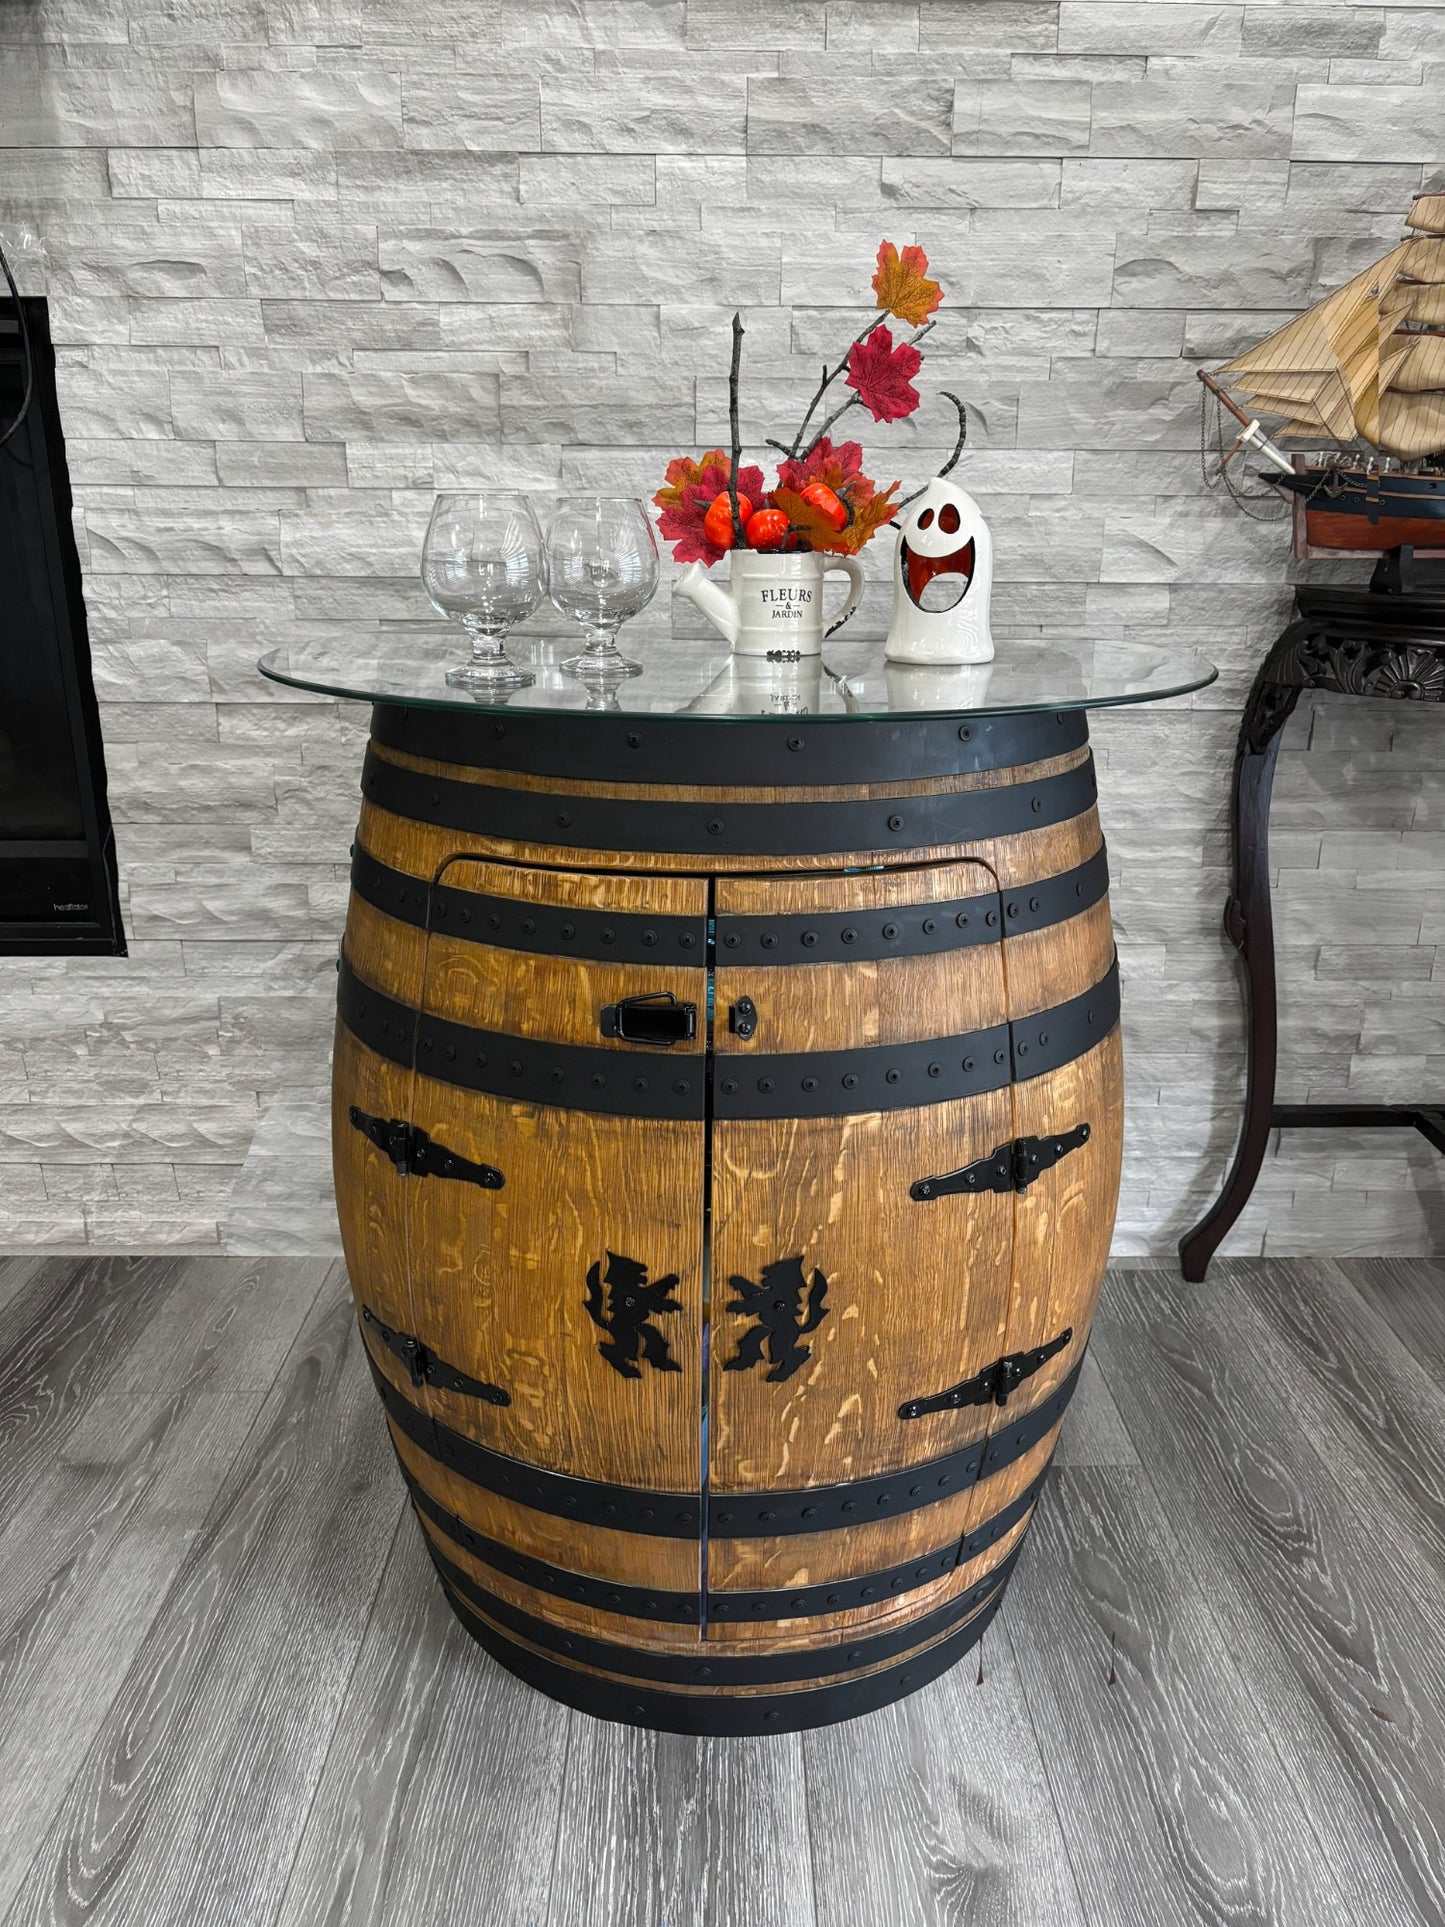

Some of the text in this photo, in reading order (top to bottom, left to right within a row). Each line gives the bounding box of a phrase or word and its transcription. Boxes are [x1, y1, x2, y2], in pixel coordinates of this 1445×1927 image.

[760, 588, 813, 603] FLEURS
[785, 601, 792, 610] &
[771, 610, 803, 619] JARDIN
